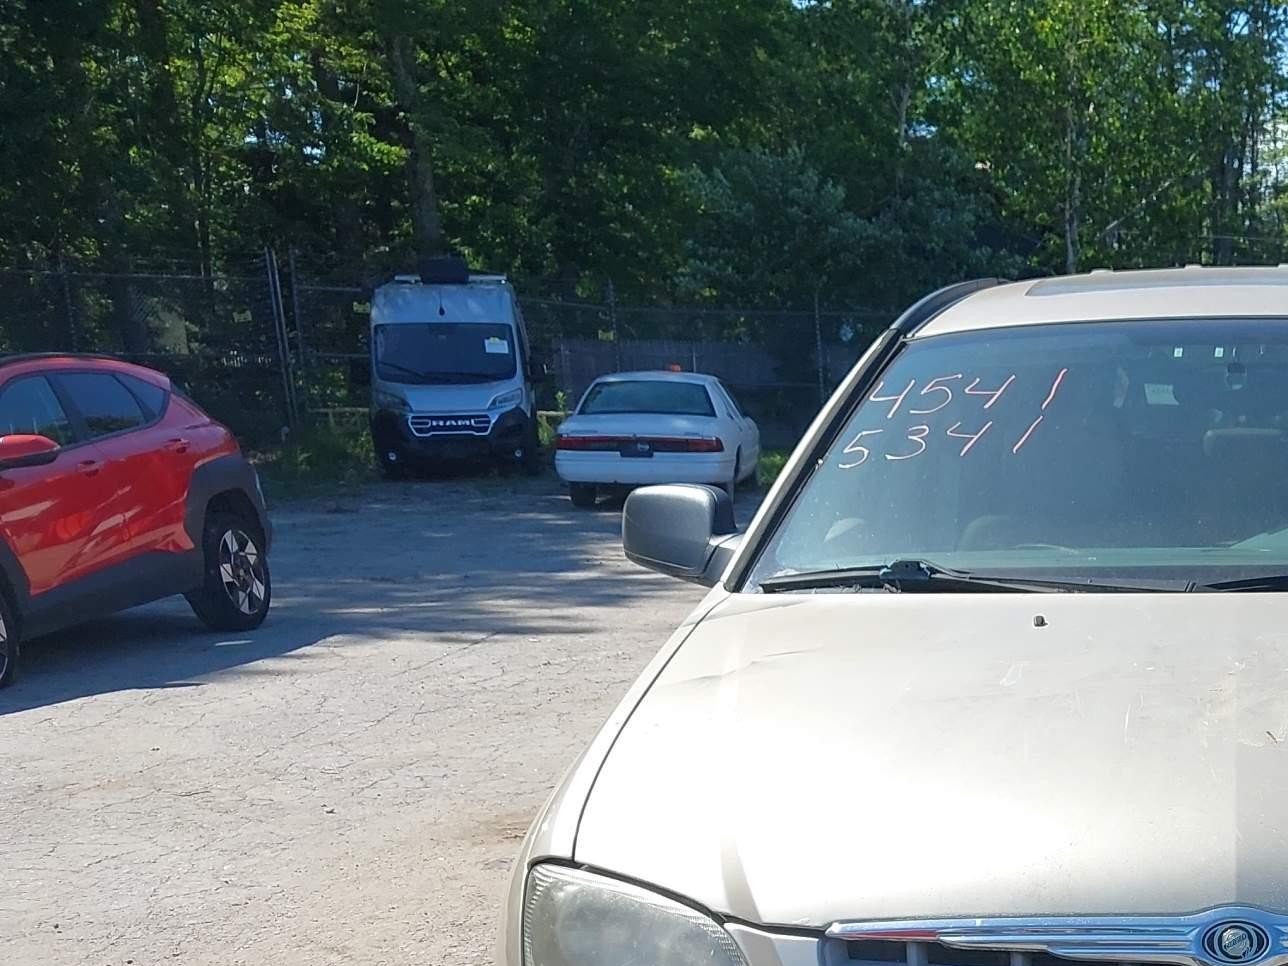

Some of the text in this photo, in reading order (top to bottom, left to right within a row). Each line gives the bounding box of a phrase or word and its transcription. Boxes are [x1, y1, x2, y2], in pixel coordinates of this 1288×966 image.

[868, 367, 1069, 419] 4541
[431, 419, 470, 427] RAM
[837, 414, 1045, 469] 5341
